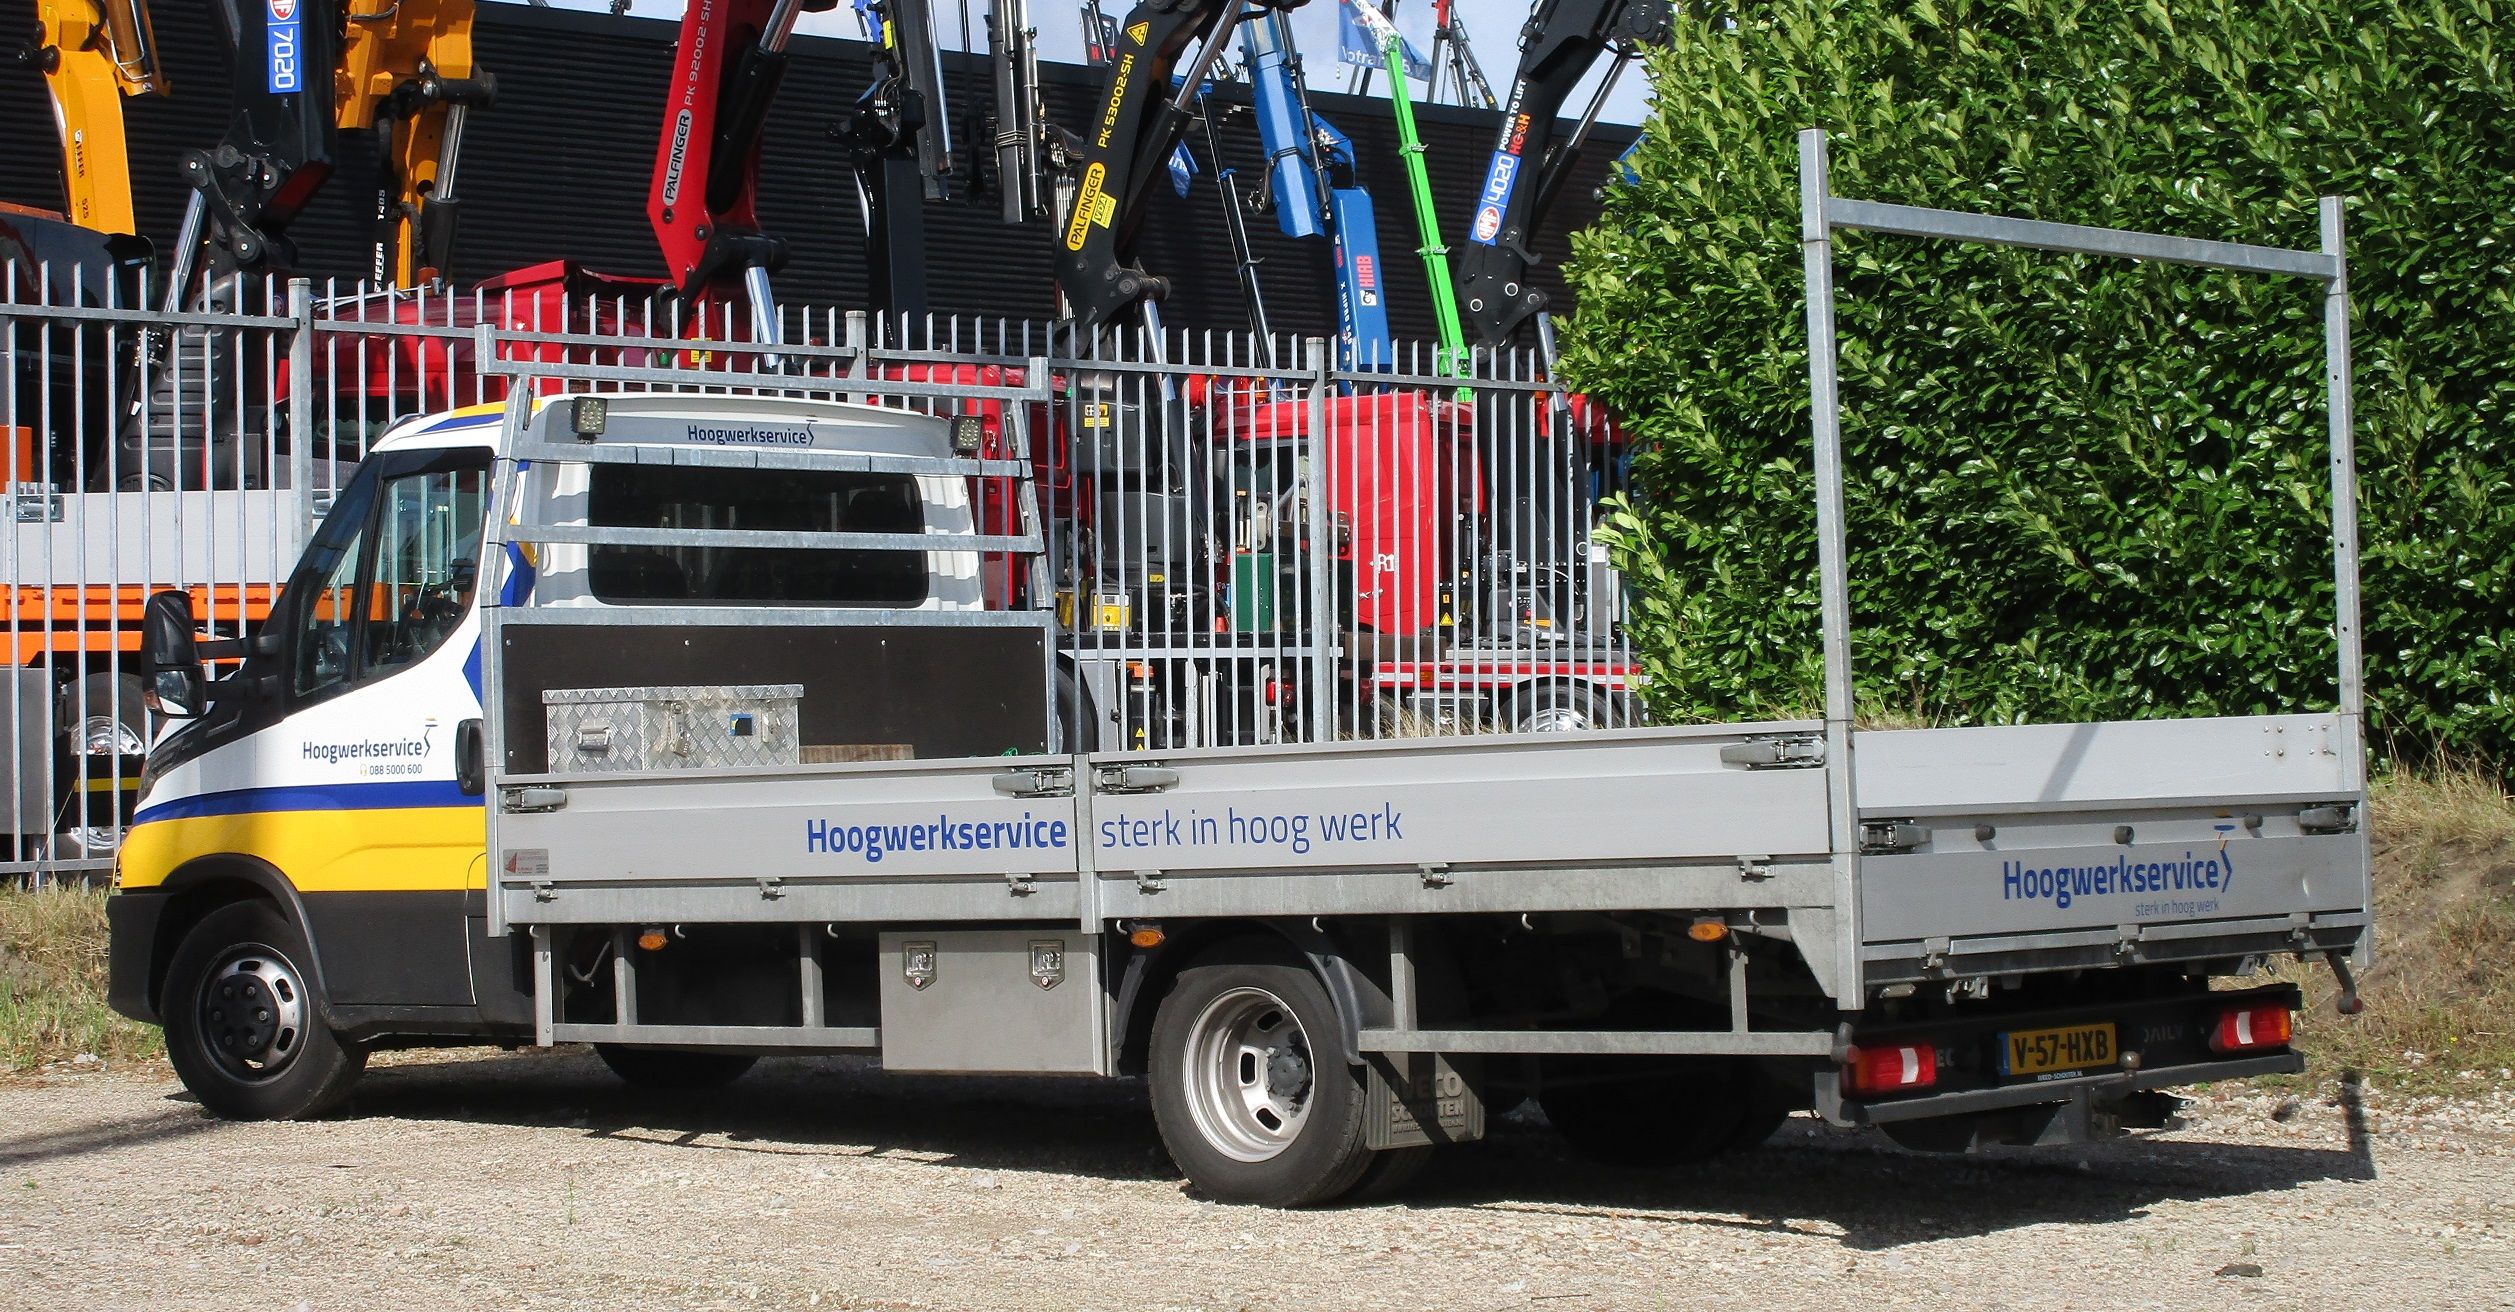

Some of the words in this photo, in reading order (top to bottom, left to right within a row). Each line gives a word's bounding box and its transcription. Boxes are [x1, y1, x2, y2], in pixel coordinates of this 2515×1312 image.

[274, 27, 295, 89] 7020
[684, 85, 696, 106] PK
[1514, 79, 1527, 100] LIFT
[1510, 100, 1521, 116] TO
[1097, 127, 1113, 149] PK
[1499, 116, 1517, 151] POWER
[664, 114, 690, 201] PALFINGER
[1487, 155, 1514, 201] 4020
[1070, 168, 1102, 246] PALFINGER
[1356, 255, 1375, 288] HIAB
[688, 425, 808, 445] Hoogwerkservice
[303, 737, 423, 764] Hoogwerkservice
[370, 765, 384, 775] 088
[386, 764, 405, 775] 5000
[407, 763, 422, 774] 600
[807, 812, 1067, 862] Hoogwerkservice
[1101, 808, 1182, 848] sterk
[1191, 809, 1218, 845] in
[1229, 806, 1310, 854] hoog
[1319, 802, 1403, 842] werk
[2003, 851, 2219, 909] Hoogwerkservice
[2135, 901, 2160, 917] sterk
[2161, 901, 2171, 915] in
[2171, 899, 2195, 917] hoog
[2196, 897, 2220, 913] werk
[2013, 1029, 2109, 1068] V-57-HXB
